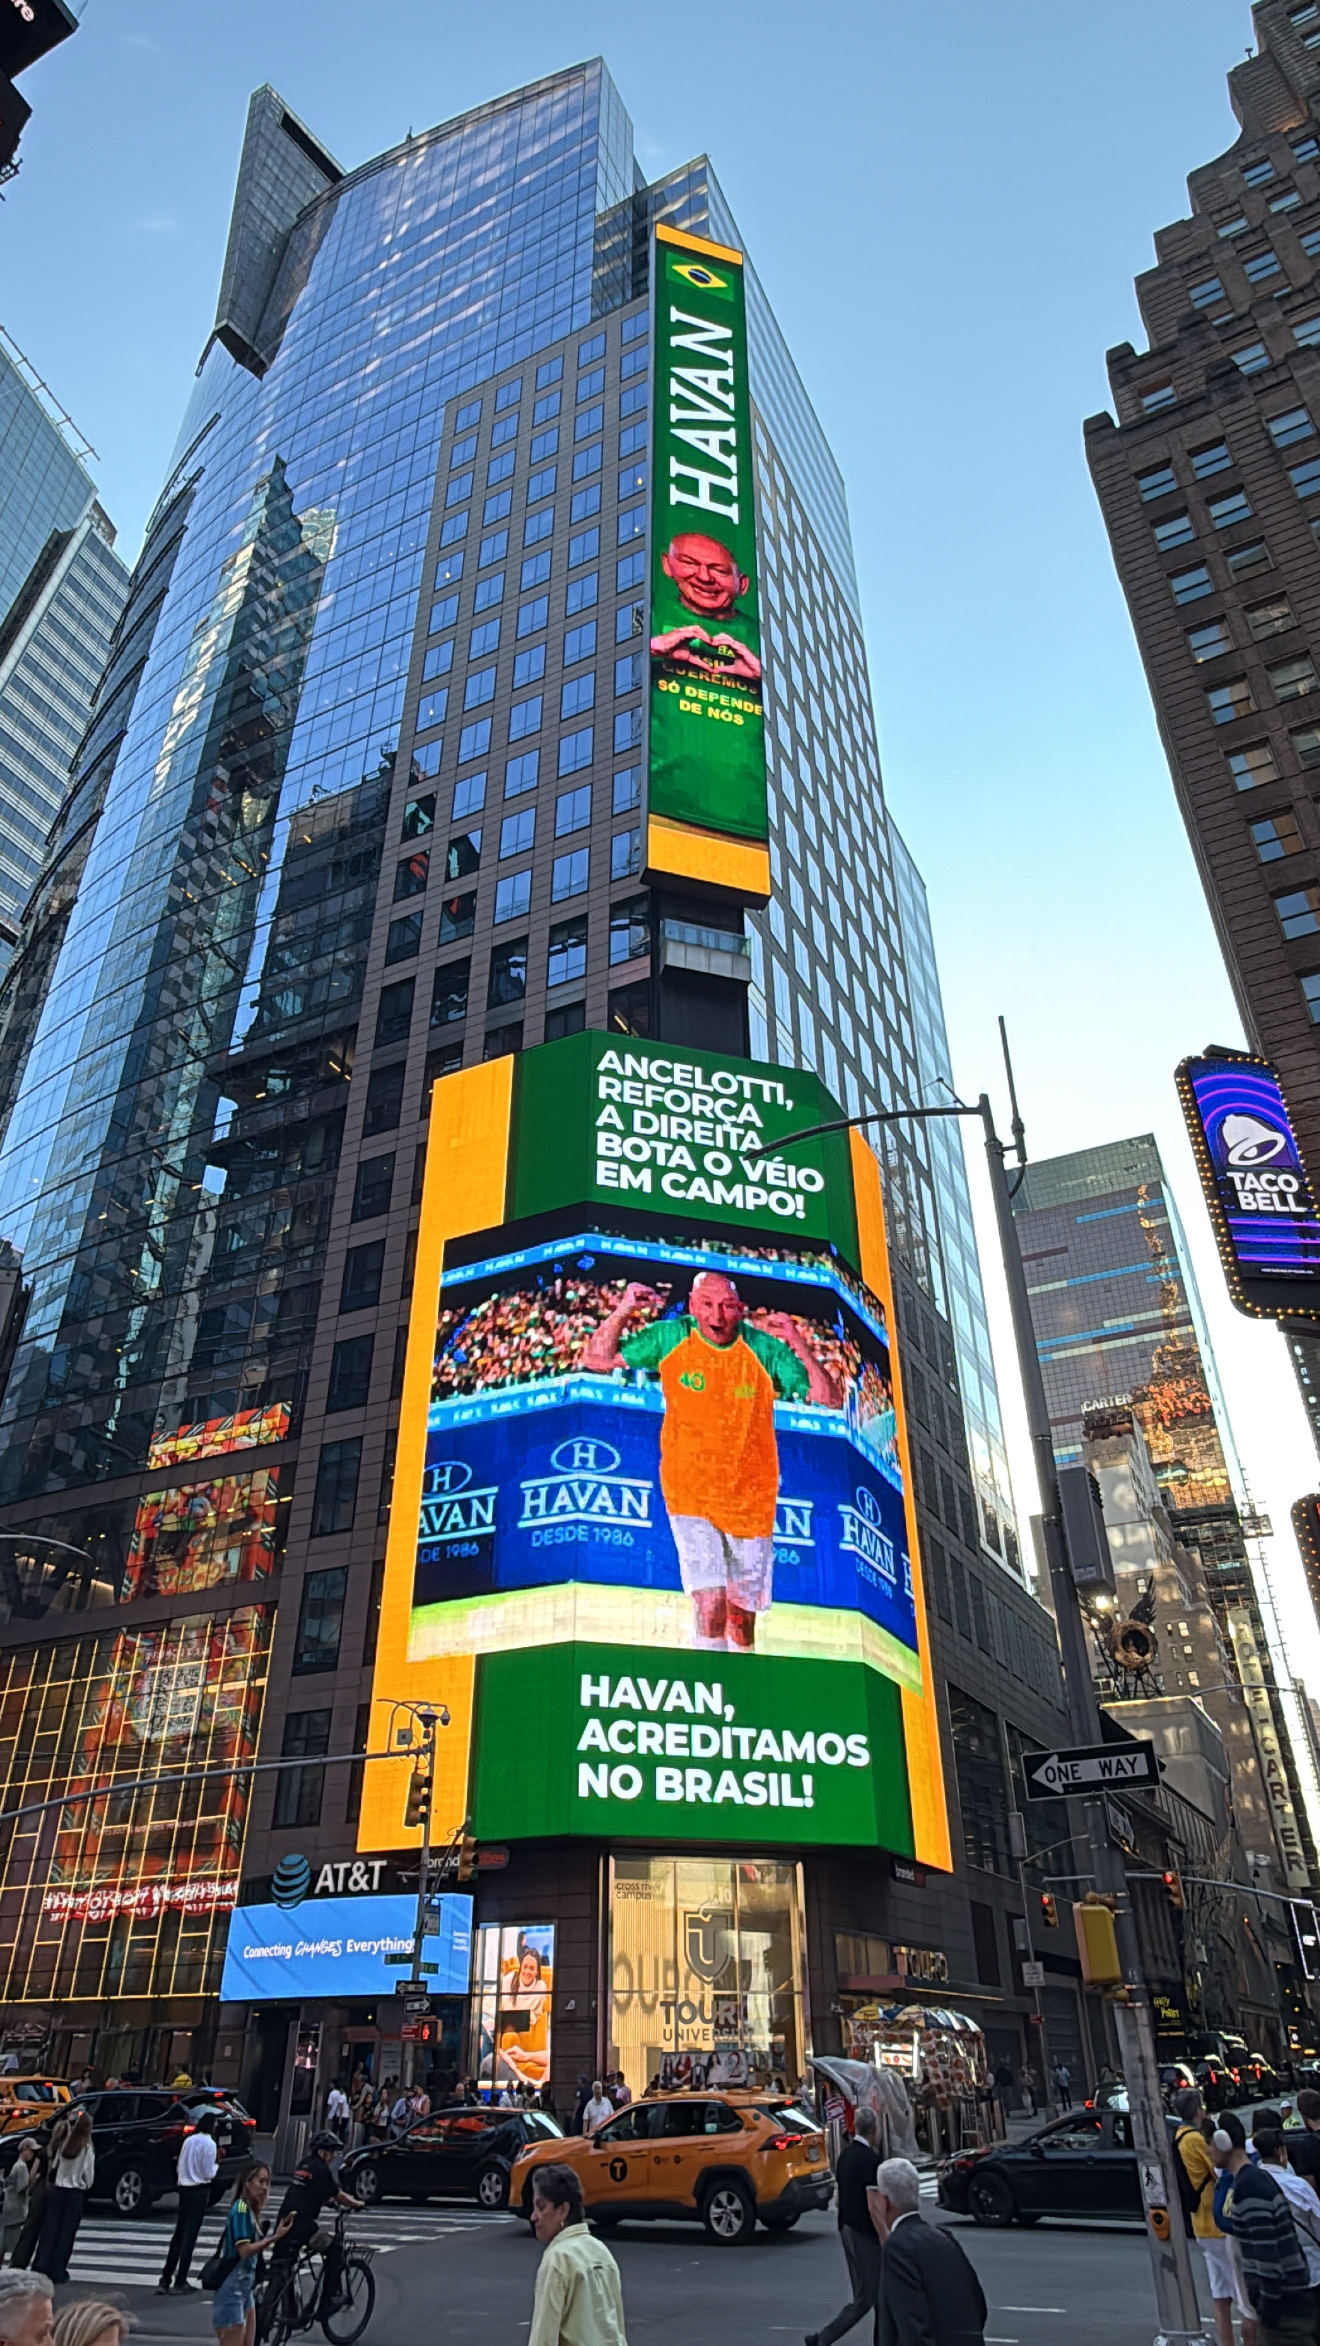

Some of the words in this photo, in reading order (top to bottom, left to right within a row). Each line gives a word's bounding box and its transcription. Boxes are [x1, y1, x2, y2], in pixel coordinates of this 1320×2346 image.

[670, 304, 739, 525] HAVAN
[658, 679, 680, 694] SÓ
[685, 685, 763, 716] DEPENDE
[679, 699, 702, 715] DE
[707, 707, 744, 726] NÓS
[597, 1050, 794, 1111] ANCELOTTI,
[598, 1075, 764, 1128] REFORÇA
[595, 1104, 625, 1131] A
[633, 1109, 764, 1152] DIREITA
[597, 1131, 697, 1171] BOTA
[703, 1151, 732, 1176] O
[738, 1156, 825, 1192] VÉIO
[596, 1160, 652, 1194] EM
[661, 1172, 806, 1220] CAMPO!
[1226, 1171, 1299, 1193] TACO
[1237, 1191, 1307, 1213] BELL
[1083, 1393, 1132, 1412] CARTER
[521, 1481, 651, 1519] HAVAN
[531, 1525, 589, 1548] DESDE
[593, 1527, 635, 1547] 1986
[840, 1513, 895, 1576] HAVAN
[580, 1674, 735, 1722] HAVAN,
[577, 1718, 870, 1767] ACREDITAMOS
[577, 1763, 643, 1800] NO
[655, 1766, 814, 1808] BRASIL!
[1044, 1763, 1082, 1783] ONE
[1098, 1756, 1137, 1778] WAY
[1260, 1737, 1304, 1871] CARTER
[314, 1860, 387, 1894] AT&T
[615, 1882, 639, 1891] cross
[616, 1890, 652, 1902] campus
[243, 1942, 292, 1960] Connecting
